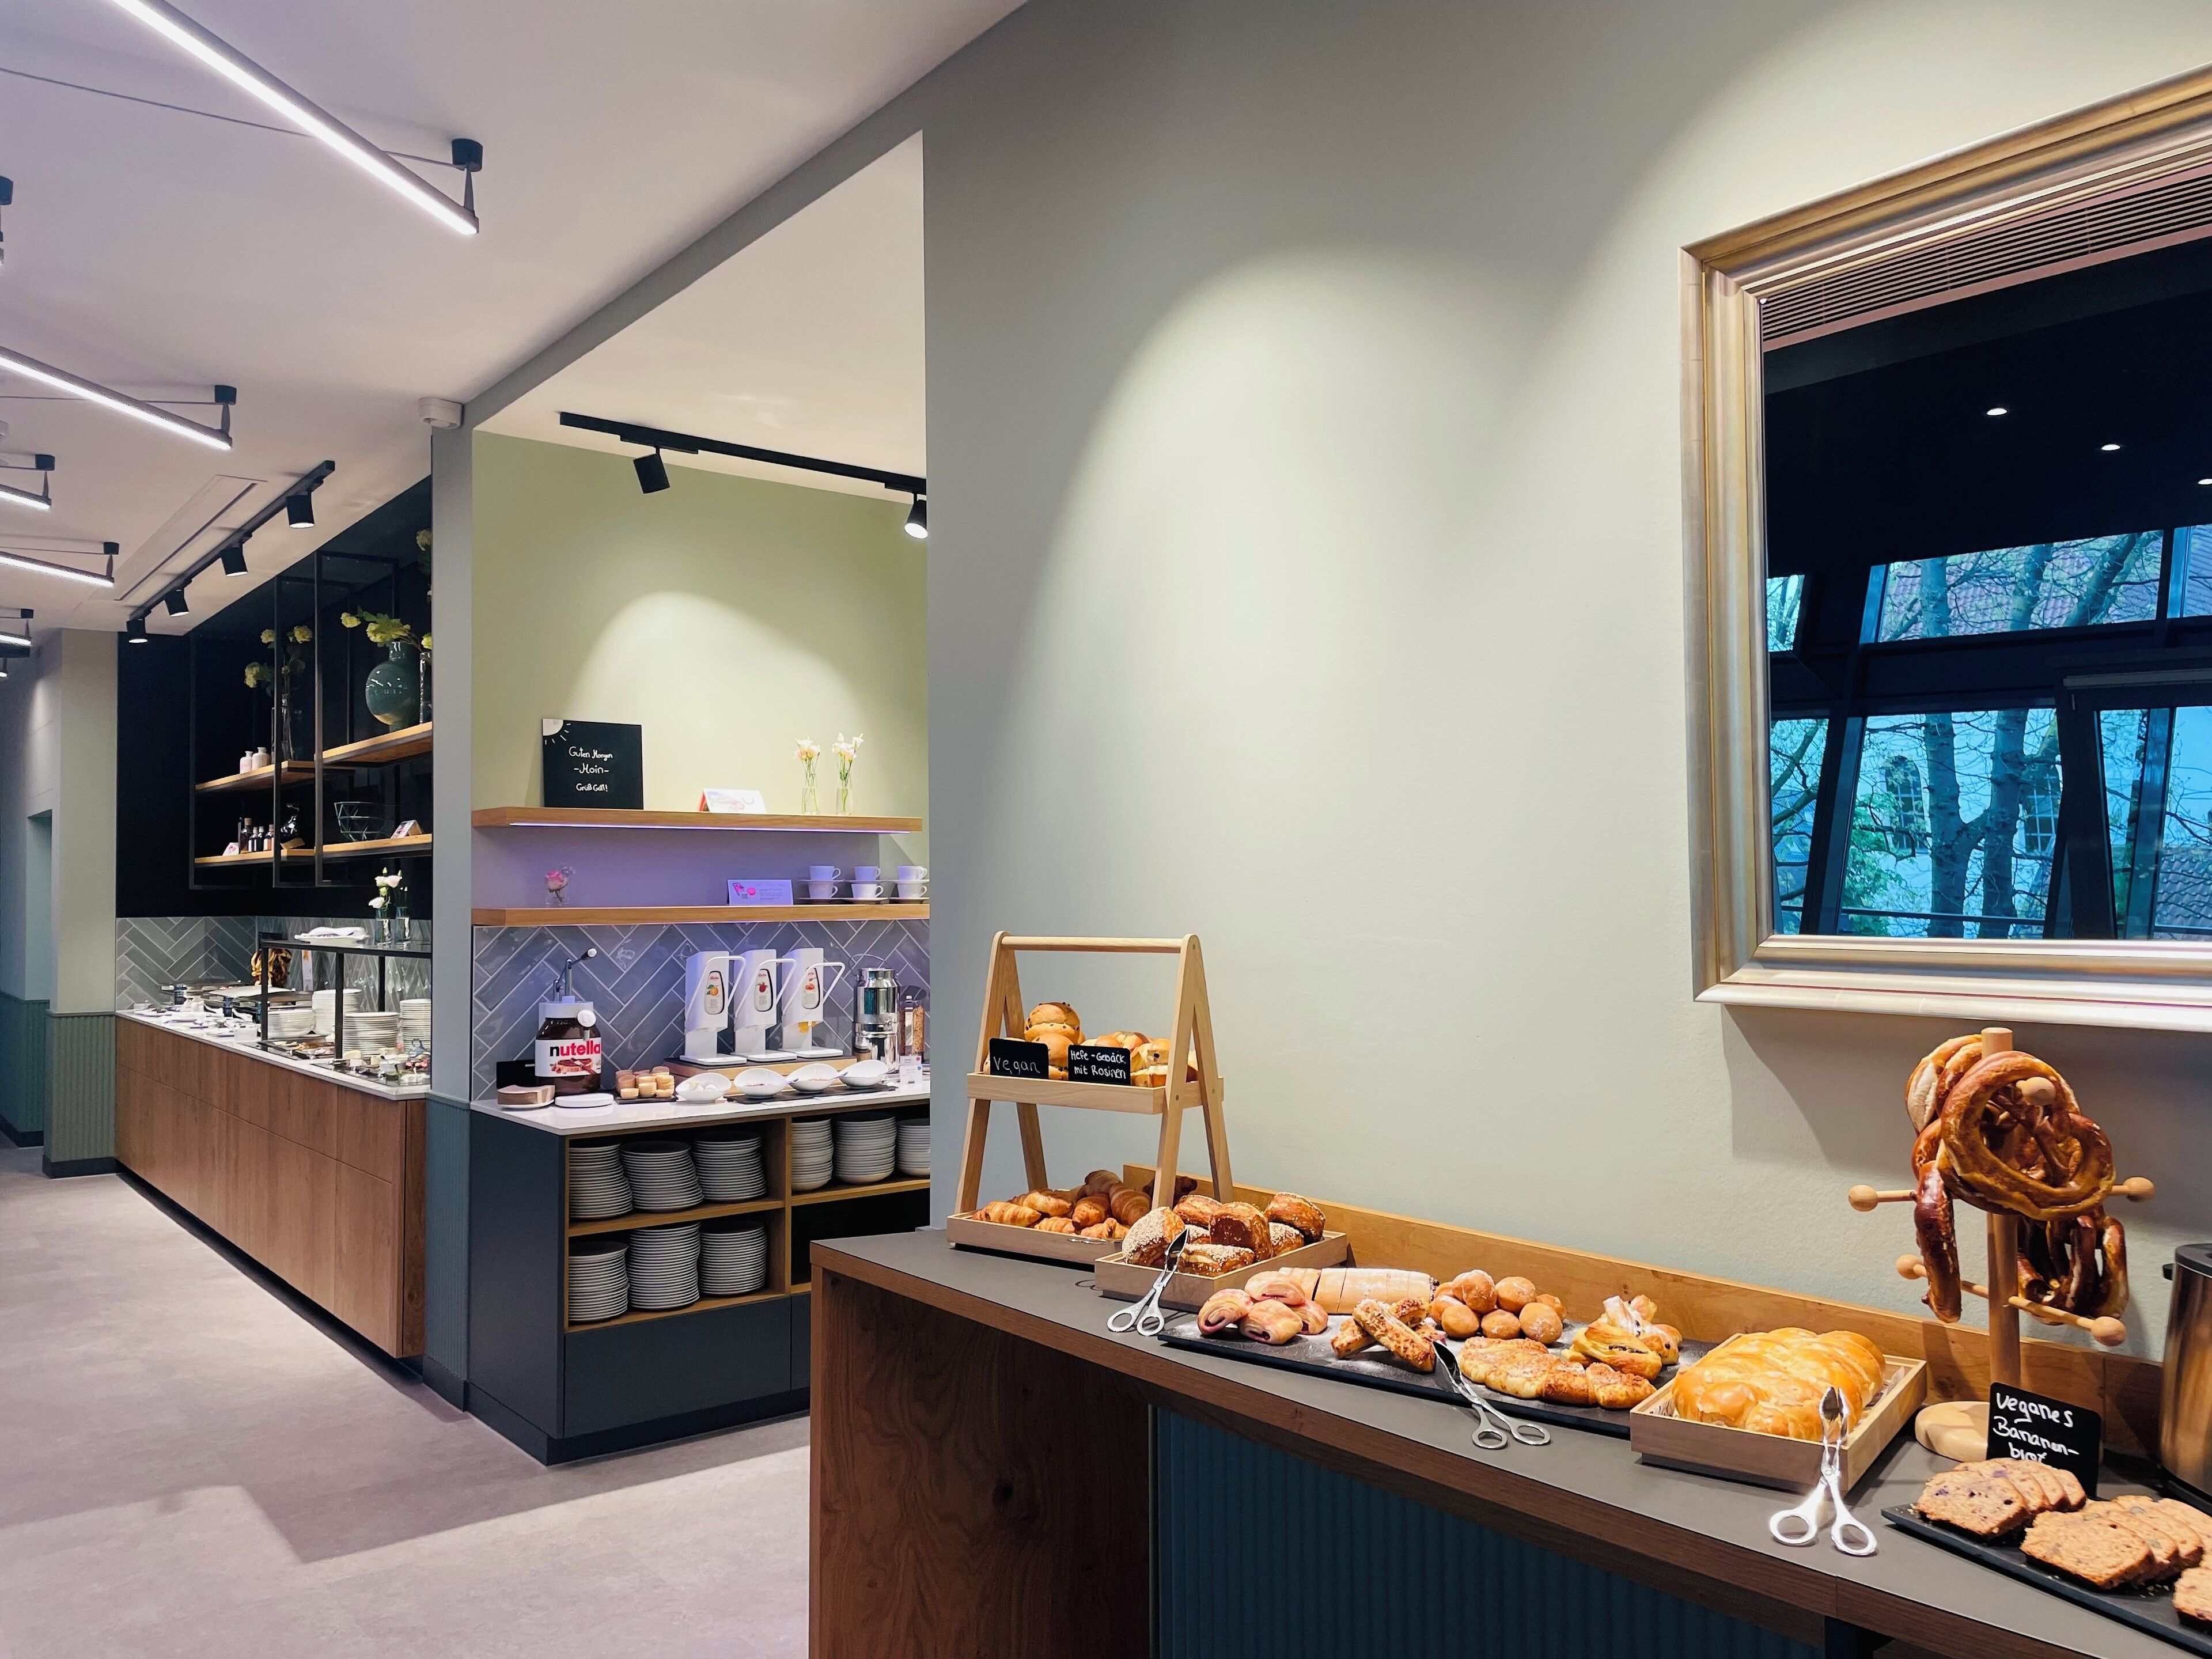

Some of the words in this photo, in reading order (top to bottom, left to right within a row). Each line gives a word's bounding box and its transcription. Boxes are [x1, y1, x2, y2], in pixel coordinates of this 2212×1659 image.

[569, 746, 590, 758] Guten
[592, 749, 613, 762] Morgen
[550, 1040, 601, 1057] nutella
[993, 1056, 1041, 1075] Vegan
[1074, 1065, 1088, 1075] mit
[1090, 1065, 1127, 1080] Rosinen
[1996, 1392, 2074, 1428] Veganes
[1993, 1415, 2080, 1456] Bananen-
